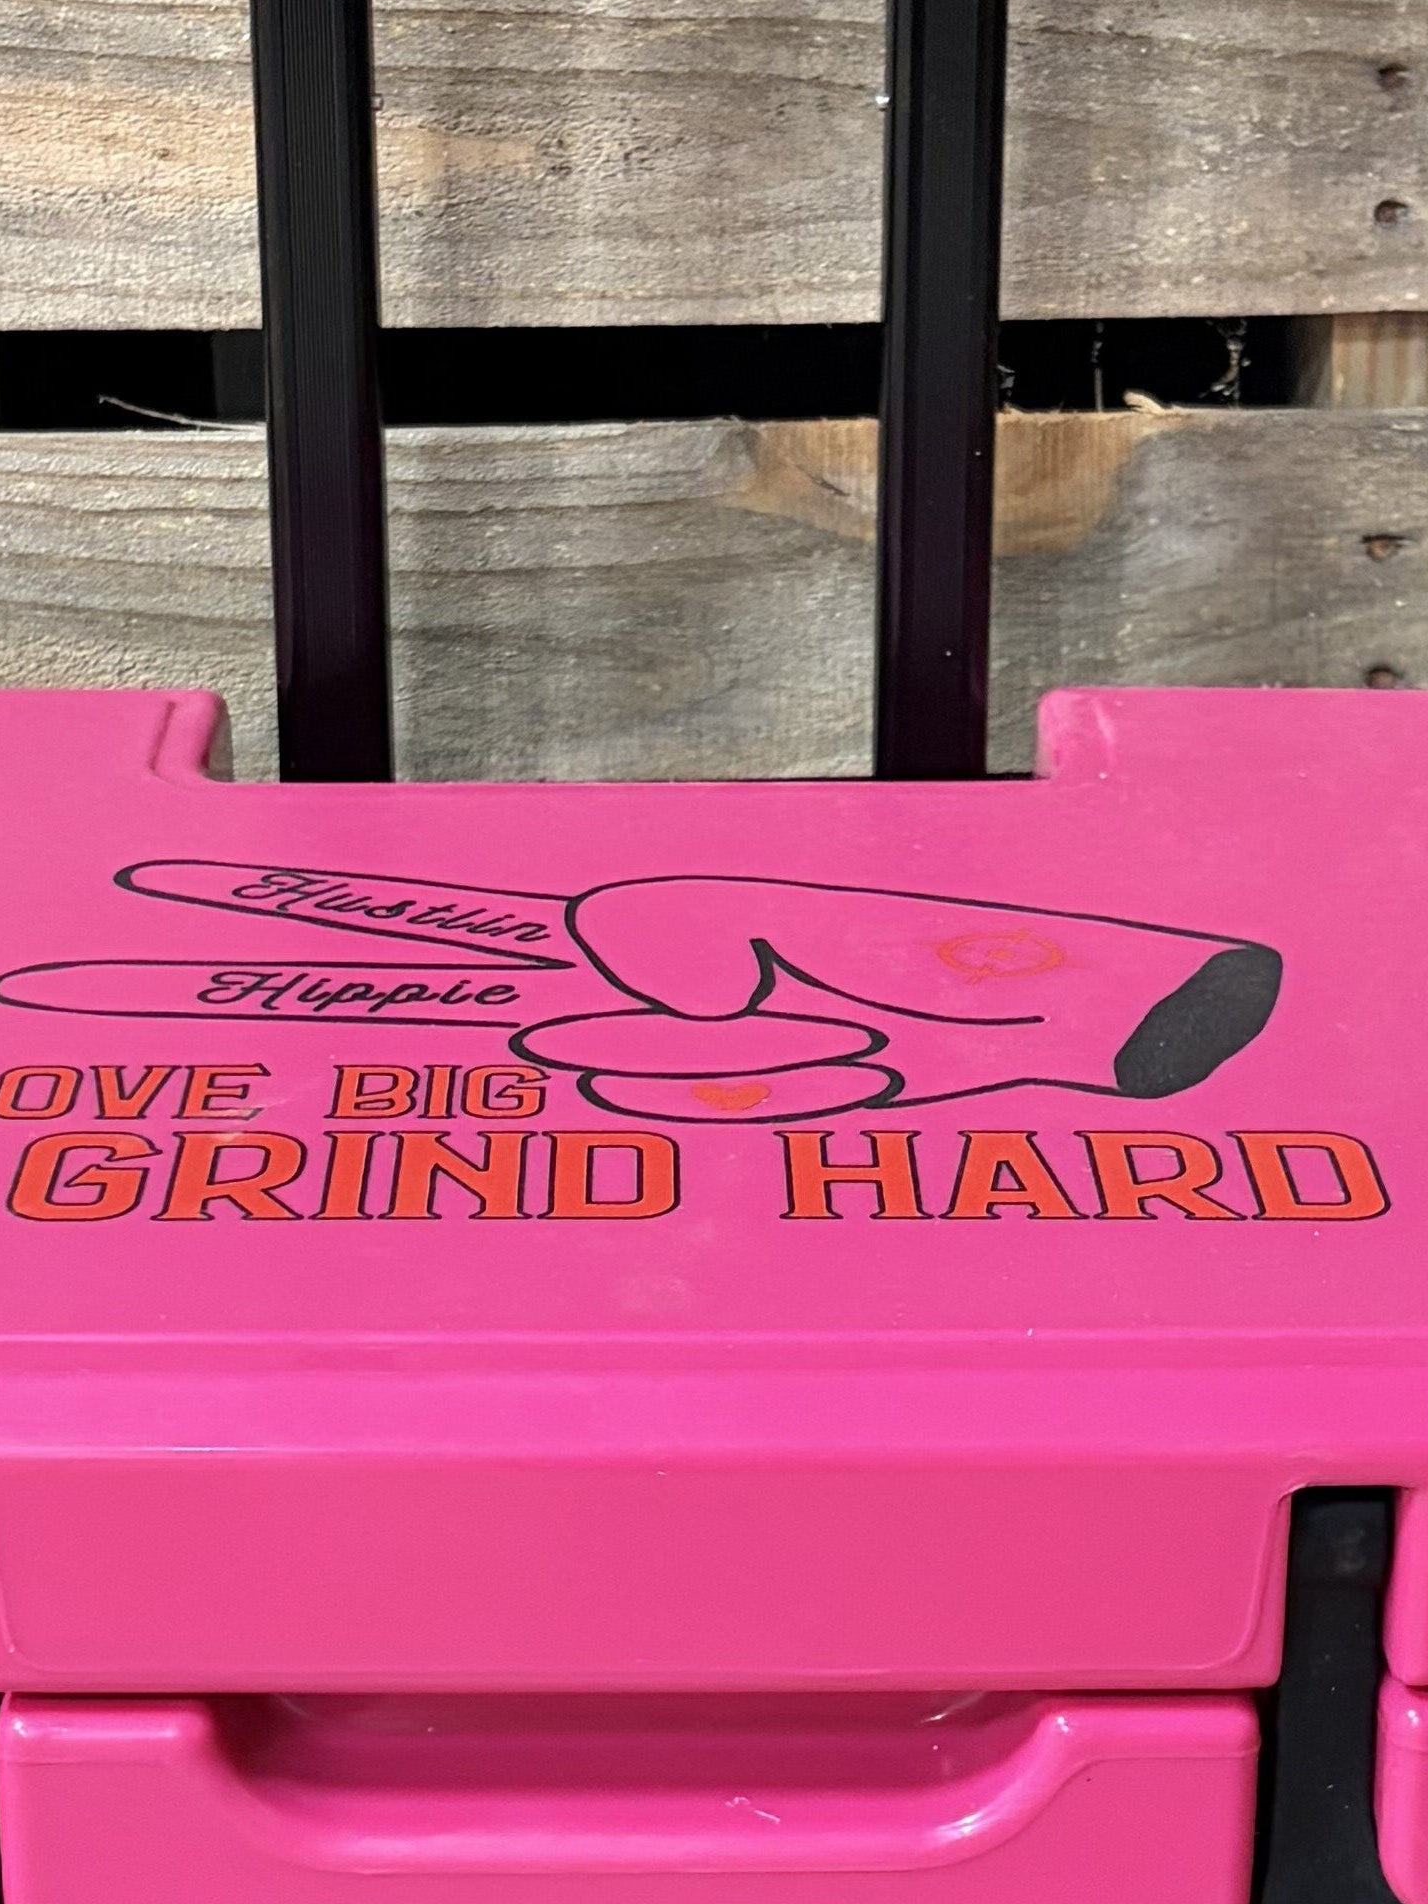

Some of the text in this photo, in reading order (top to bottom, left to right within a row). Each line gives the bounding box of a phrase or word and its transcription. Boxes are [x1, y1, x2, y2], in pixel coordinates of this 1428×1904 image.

[231, 870, 552, 943] Hustlin
[197, 971, 521, 1013] Hippie
[325, 1063, 551, 1121] BIG
[6, 1130, 1392, 1223] GRIND HARD
